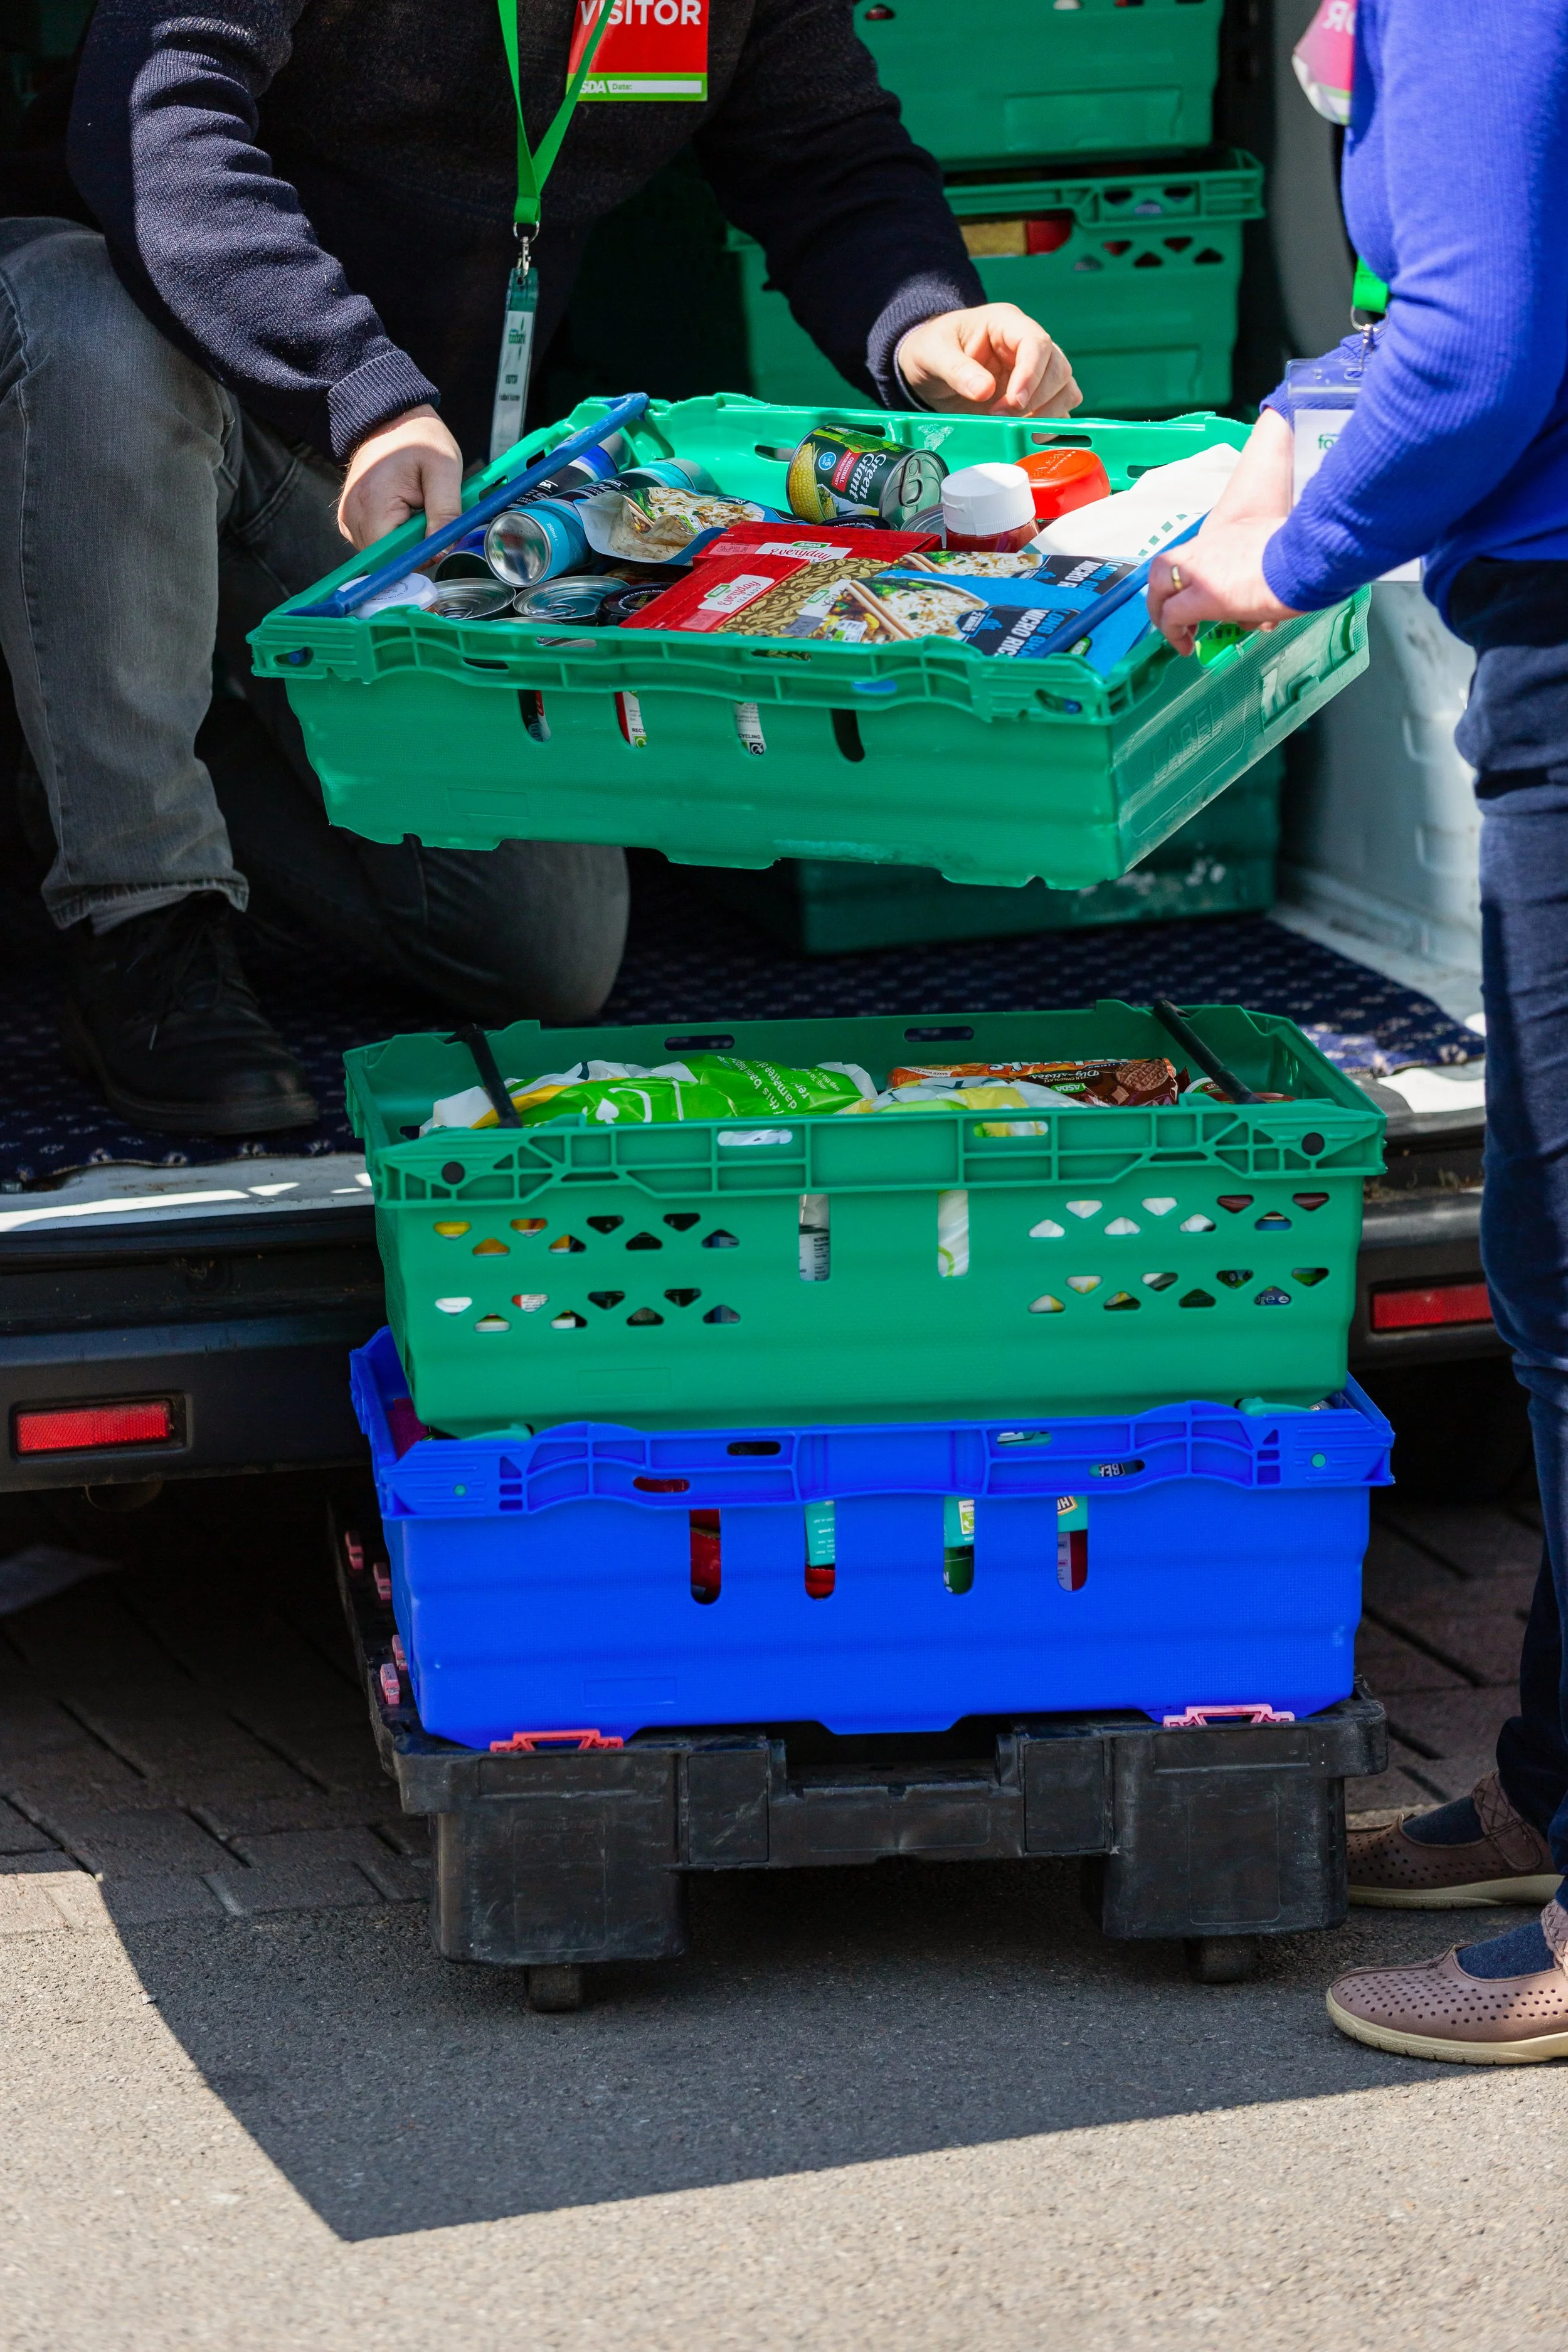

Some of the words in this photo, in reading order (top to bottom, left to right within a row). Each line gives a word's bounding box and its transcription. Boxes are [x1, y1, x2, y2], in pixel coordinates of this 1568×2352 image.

[580, 80, 607, 93] SDA
[839, 457, 854, 484] ORIGINAL
[849, 453, 874, 501] Giant
[860, 453, 887, 499] Green
[770, 548, 832, 561] Everyday
[1065, 559, 1103, 582] MICRO
[1089, 561, 1124, 581] LONG
[717, 580, 761, 607] Everyday
[1010, 609, 1051, 638] MICRO
[1036, 608, 1070, 635] LONG
[762, 1086, 781, 1110] this
[1055, 1083, 1081, 1092] ASDA
